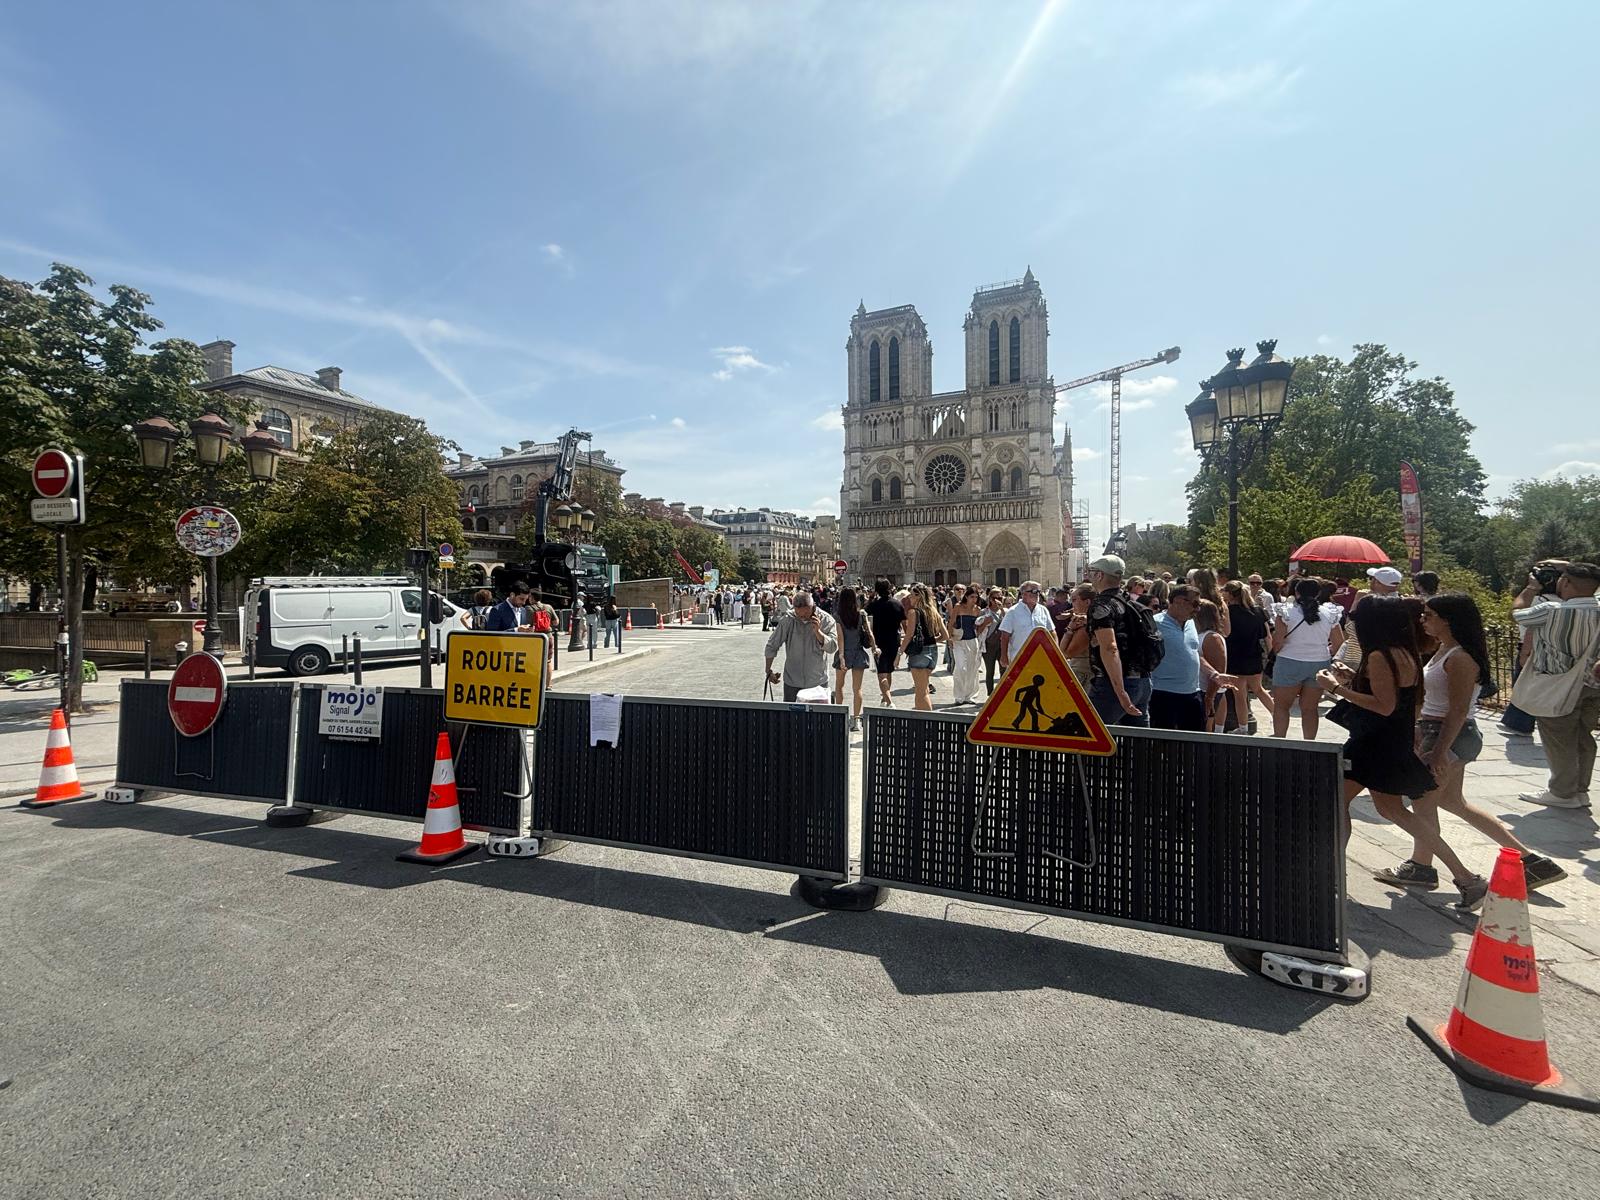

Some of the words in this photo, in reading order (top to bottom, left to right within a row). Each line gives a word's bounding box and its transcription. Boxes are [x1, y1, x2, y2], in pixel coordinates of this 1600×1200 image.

[462, 650, 526, 673] ROUTE
[328, 688, 375, 716] mojo
[454, 682, 531, 709] BARRÉE
[330, 705, 350, 716] Signal
[345, 726, 353, 734] 54
[355, 726, 363, 734] 42
[364, 727, 372, 735] 54
